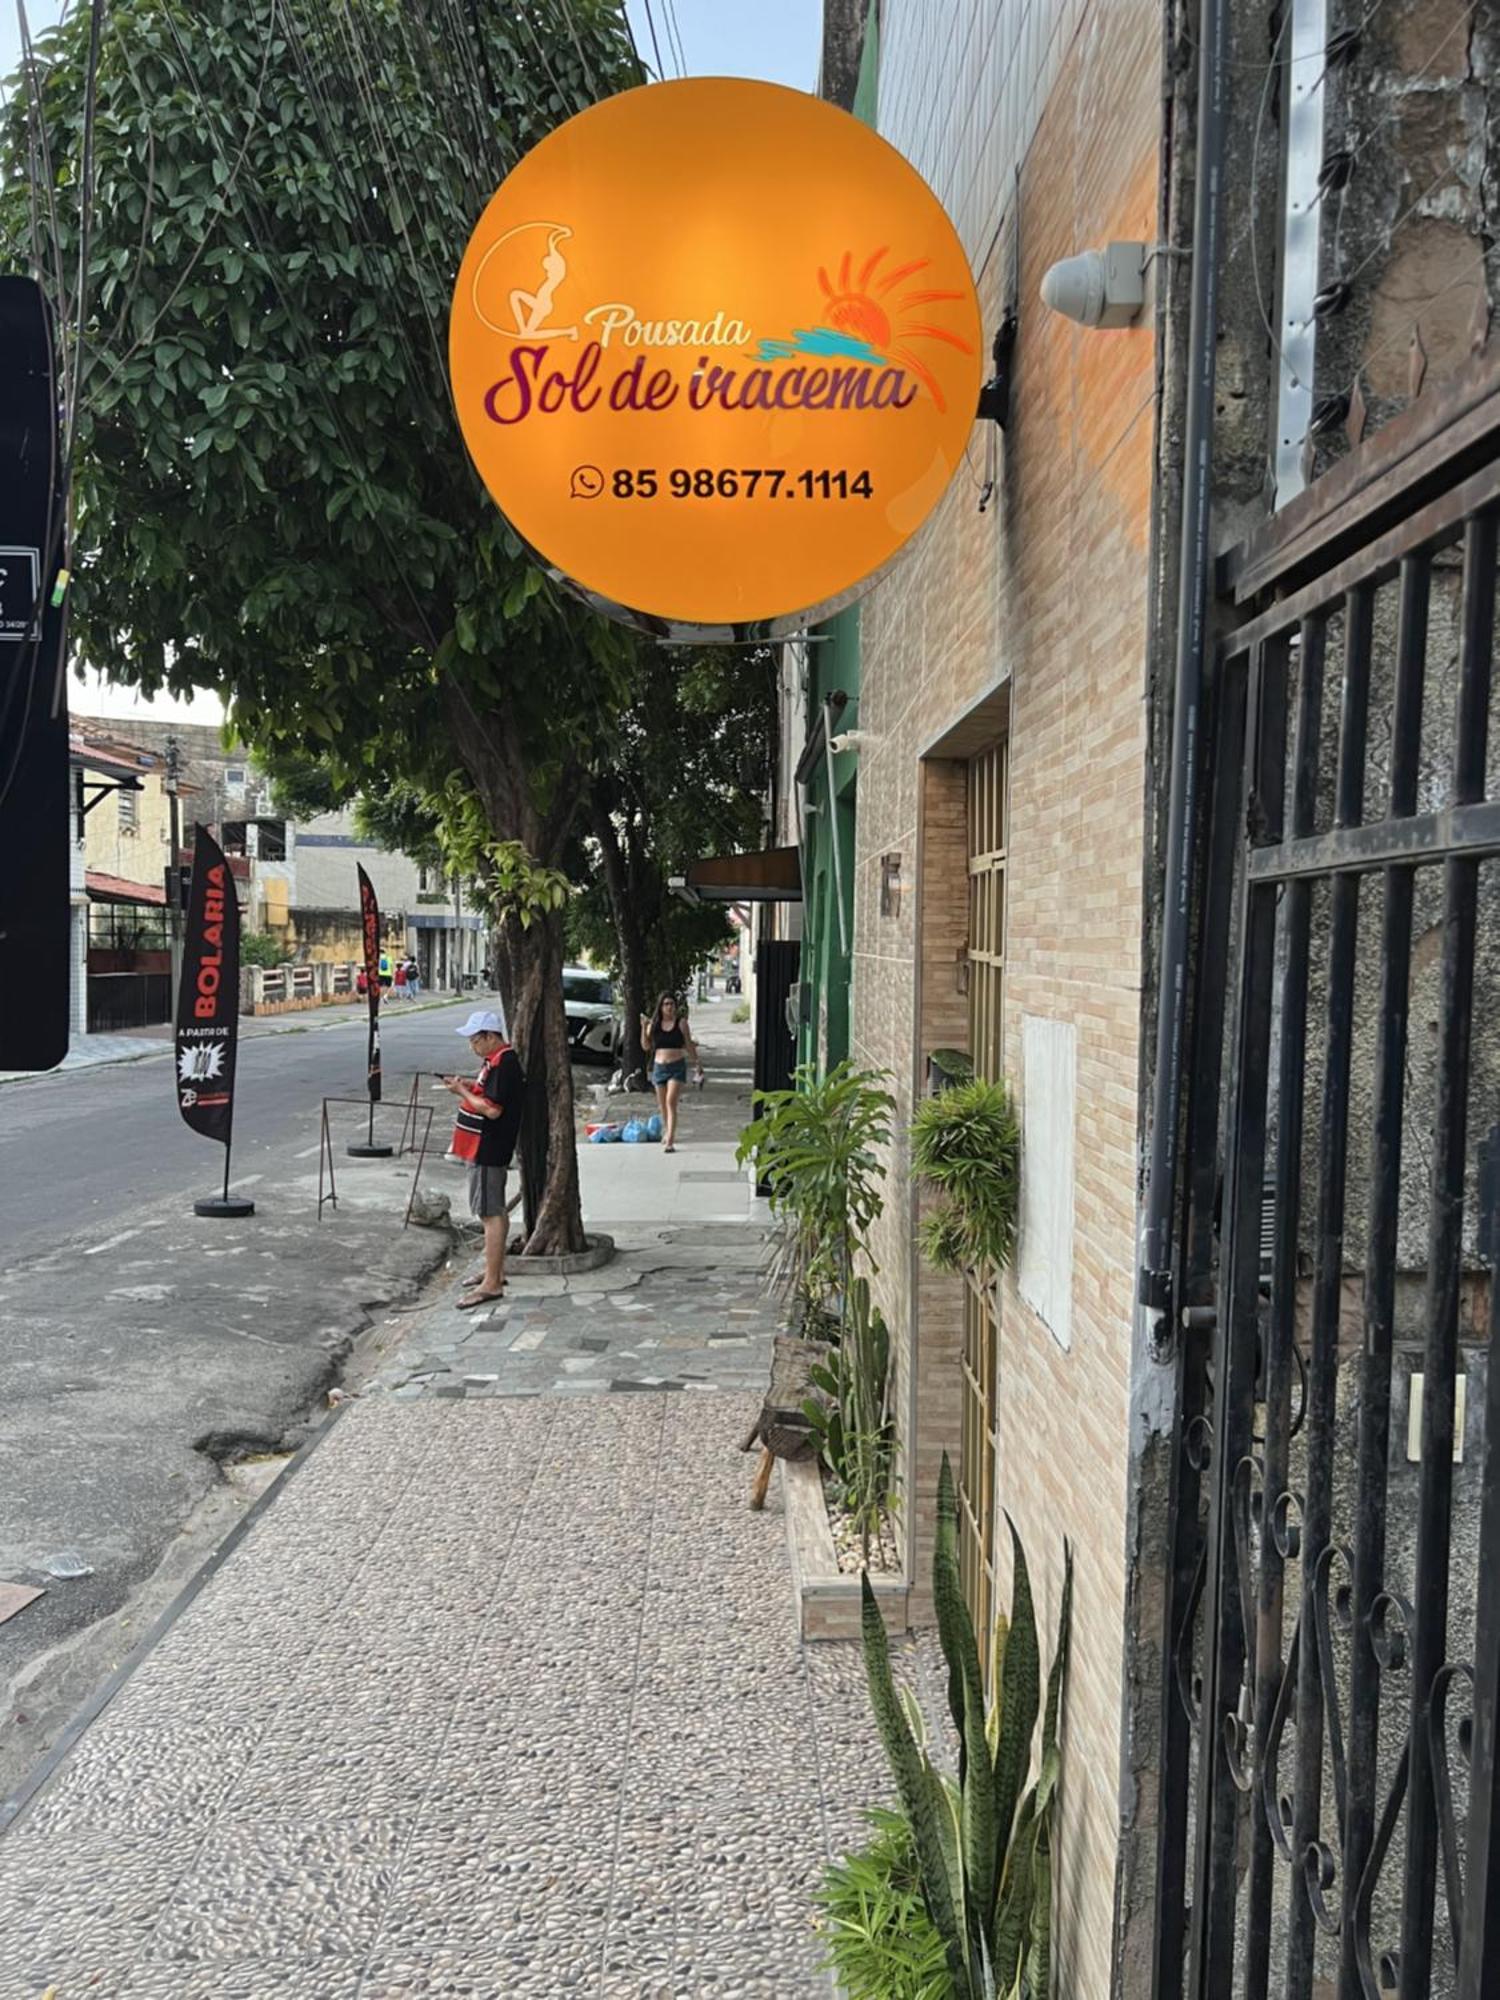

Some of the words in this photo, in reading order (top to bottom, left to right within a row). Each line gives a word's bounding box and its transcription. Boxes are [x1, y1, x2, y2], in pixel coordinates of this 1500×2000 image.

[584, 303, 750, 347] Pousada
[484, 342, 601, 425] Sol
[608, 355, 680, 411] de
[612, 468, 658, 499] 85
[670, 468, 873, 499] 98677.1114
[194, 863, 226, 1018] BOLARIA
[178, 1028, 187, 1036] A
[215, 1027, 229, 1036] DE
